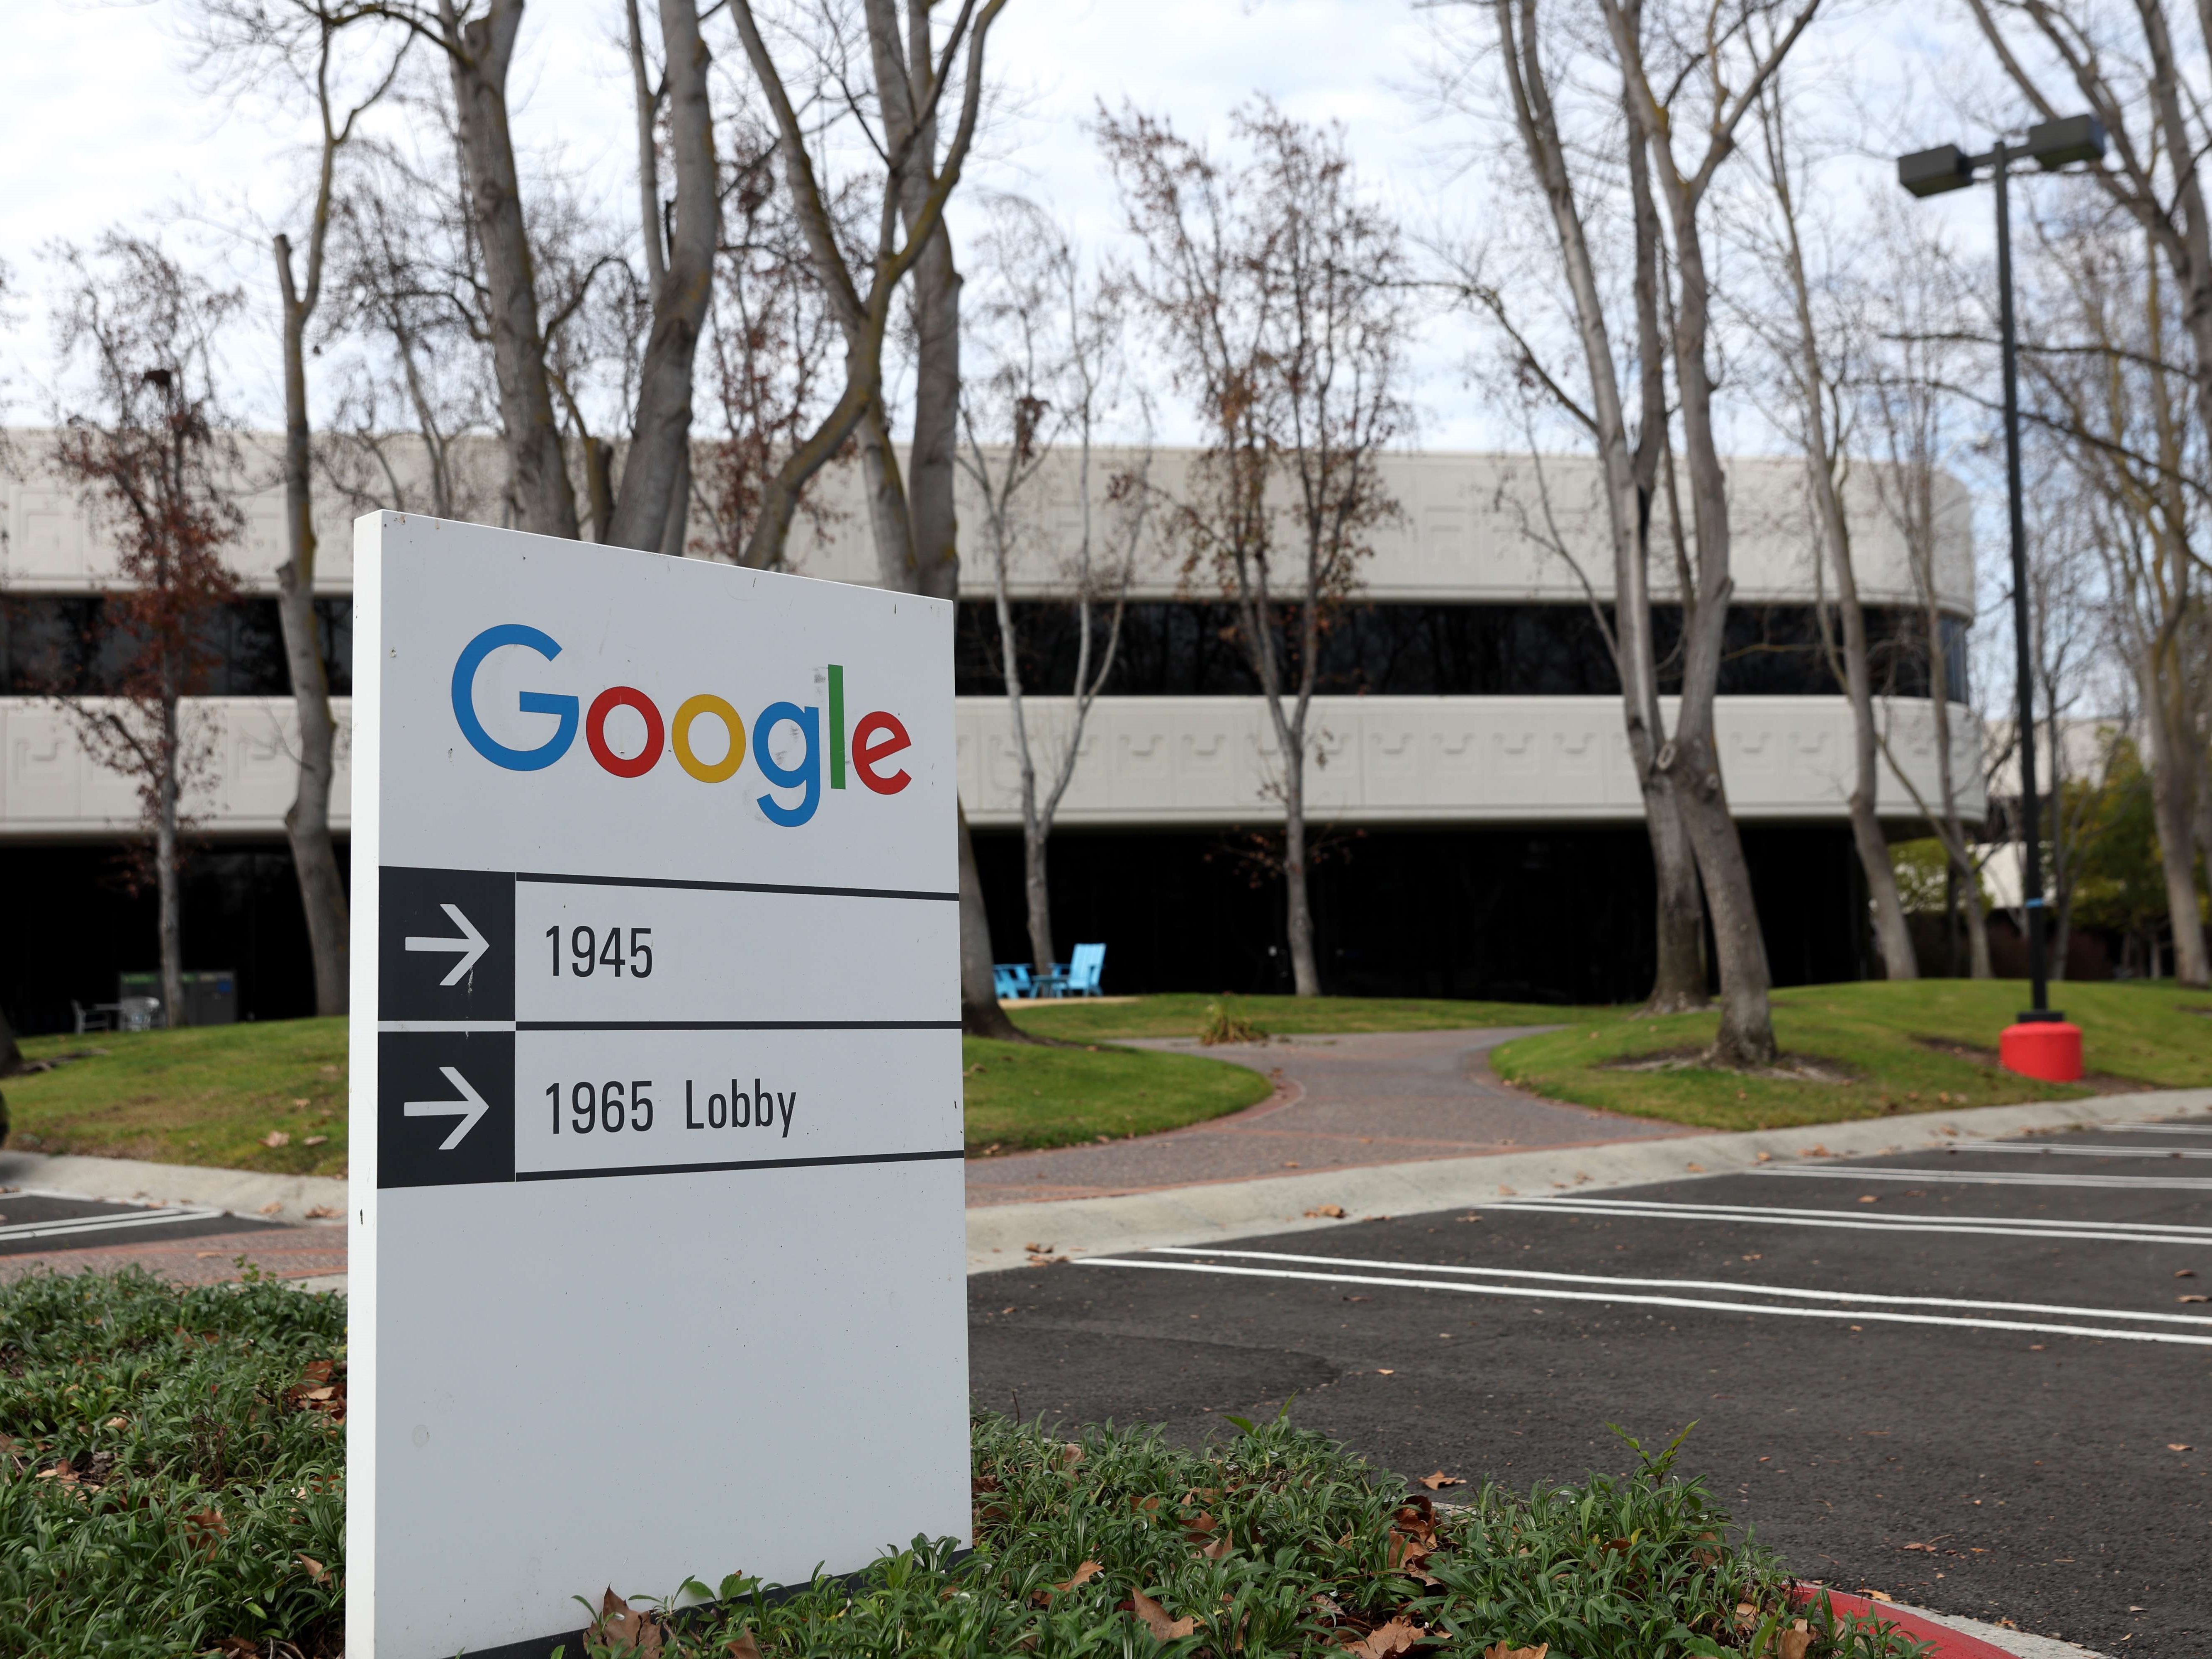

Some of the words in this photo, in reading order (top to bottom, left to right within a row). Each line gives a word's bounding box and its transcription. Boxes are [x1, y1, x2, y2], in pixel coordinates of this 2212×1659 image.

[451, 623, 912, 828] Google
[545, 925, 653, 979] 1945
[545, 1080, 654, 1135] 1965
[686, 1078, 797, 1138] Lobby
